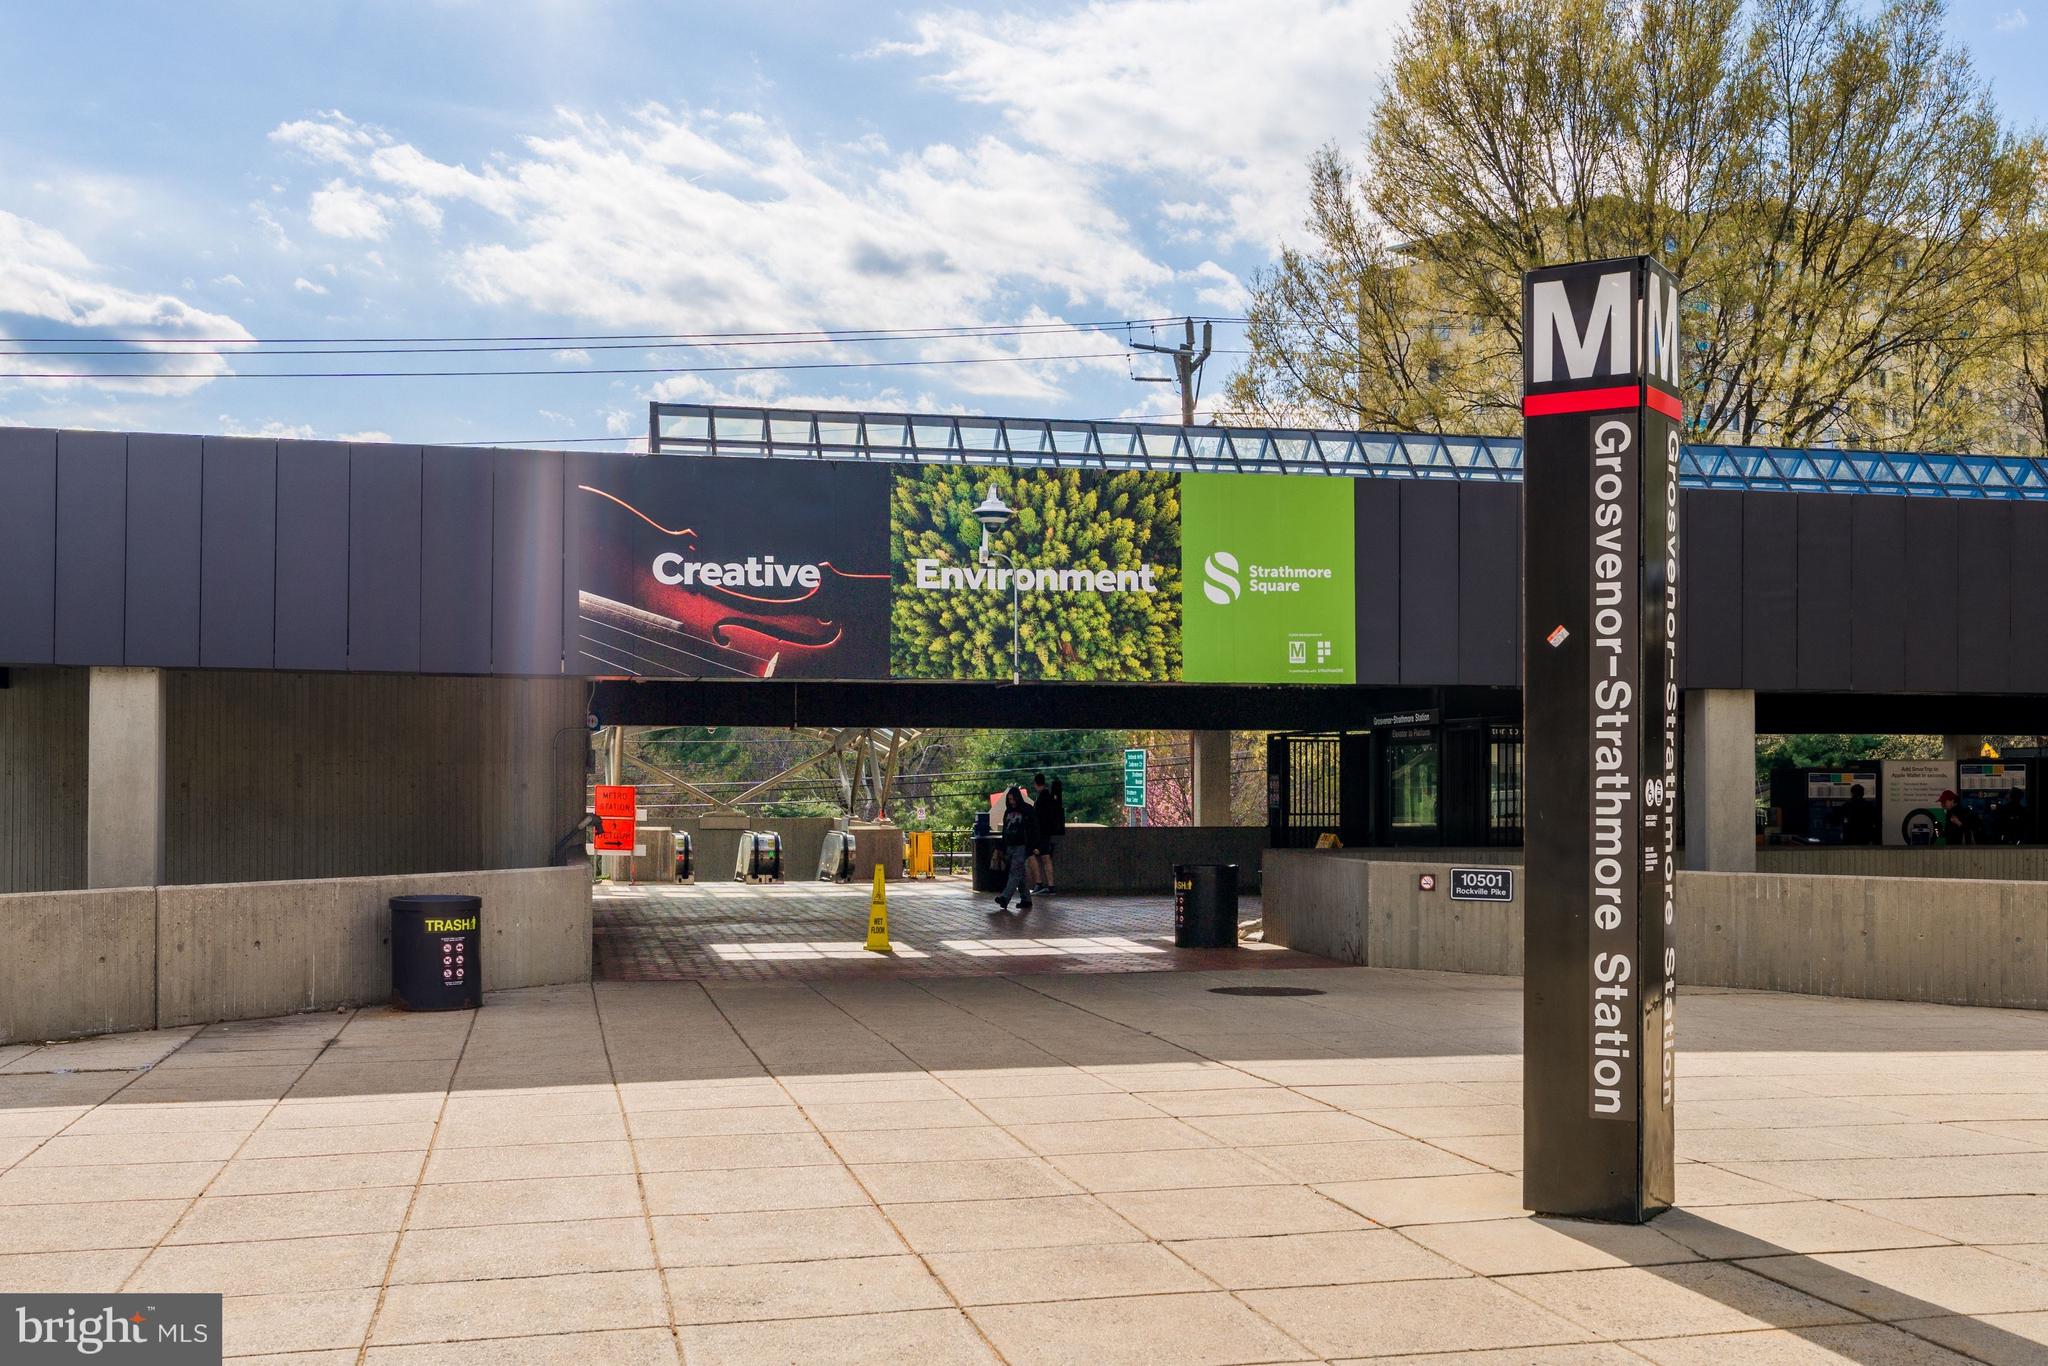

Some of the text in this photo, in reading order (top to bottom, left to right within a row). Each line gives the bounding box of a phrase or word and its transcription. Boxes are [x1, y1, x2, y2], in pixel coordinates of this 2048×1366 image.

[1533, 271, 1631, 383] M
[1648, 272, 1679, 388] M
[652, 552, 822, 588] Creative
[916, 558, 1157, 592] Environment
[1249, 565, 1332, 578] Strathmore
[1249, 580, 1300, 594] Square
[1415, 712, 1430, 722] Station
[1593, 420, 1632, 1114] Grosvenor-Strathmore Station
[1663, 430, 1680, 1105] Grosvenor-Strathmore Station
[602, 792, 627, 800] METRO
[600, 803, 631, 812] STATION
[1460, 873, 1503, 887] 10501
[1456, 887, 1507, 896] Rockville Pike
[873, 917, 883, 926] WET
[870, 926, 886, 935] FLOOR
